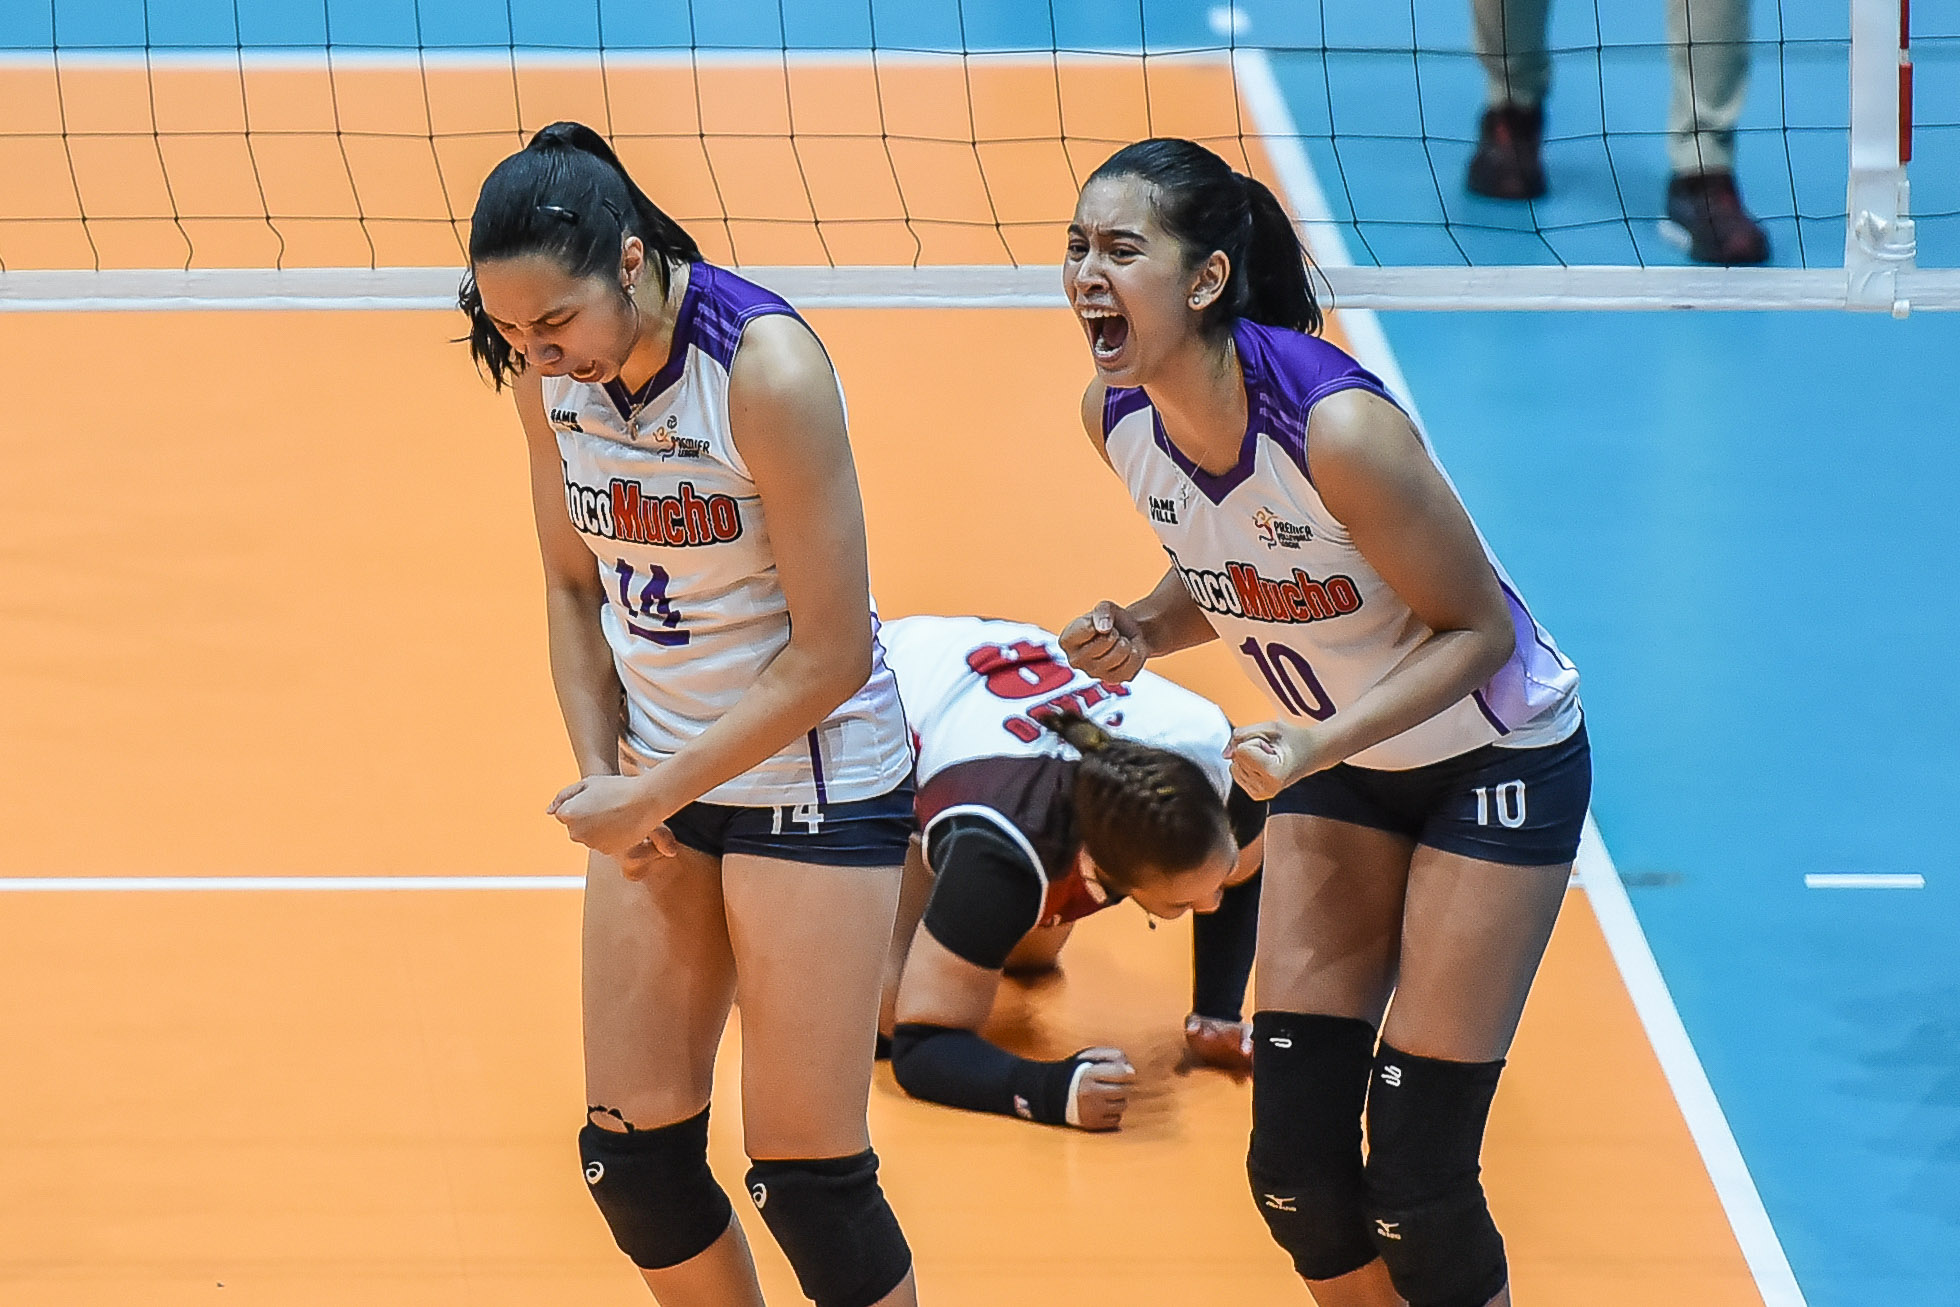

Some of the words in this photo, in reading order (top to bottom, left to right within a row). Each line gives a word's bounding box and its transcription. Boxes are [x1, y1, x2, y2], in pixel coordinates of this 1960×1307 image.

[1150, 507, 1179, 525] VILLE
[615, 557, 682, 628] 14
[1239, 636, 1337, 722] 10
[771, 804, 825, 835] 14
[1471, 779, 1526, 829] 10
